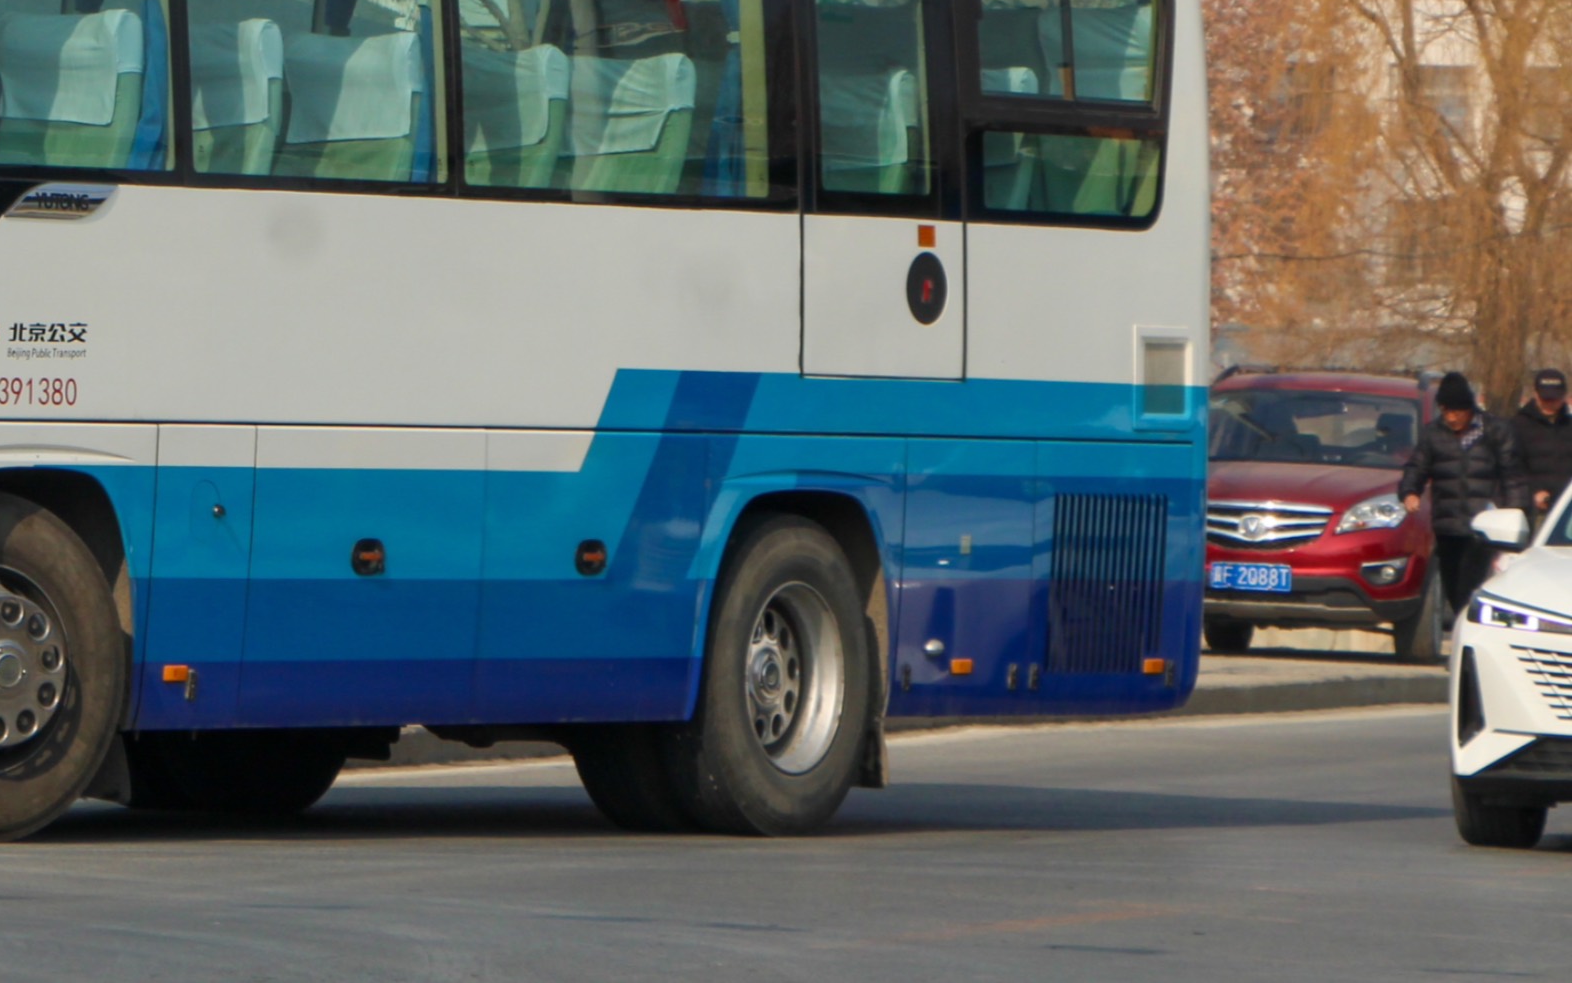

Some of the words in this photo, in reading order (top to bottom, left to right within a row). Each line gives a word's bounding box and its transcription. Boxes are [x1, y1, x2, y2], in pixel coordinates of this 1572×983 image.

[35, 192, 89, 210] YUTONG
[7, 322, 88, 343] 北京公交
[7, 347, 31, 360] Beijing
[31, 348, 52, 358] Public
[52, 348, 87, 360] Transport
